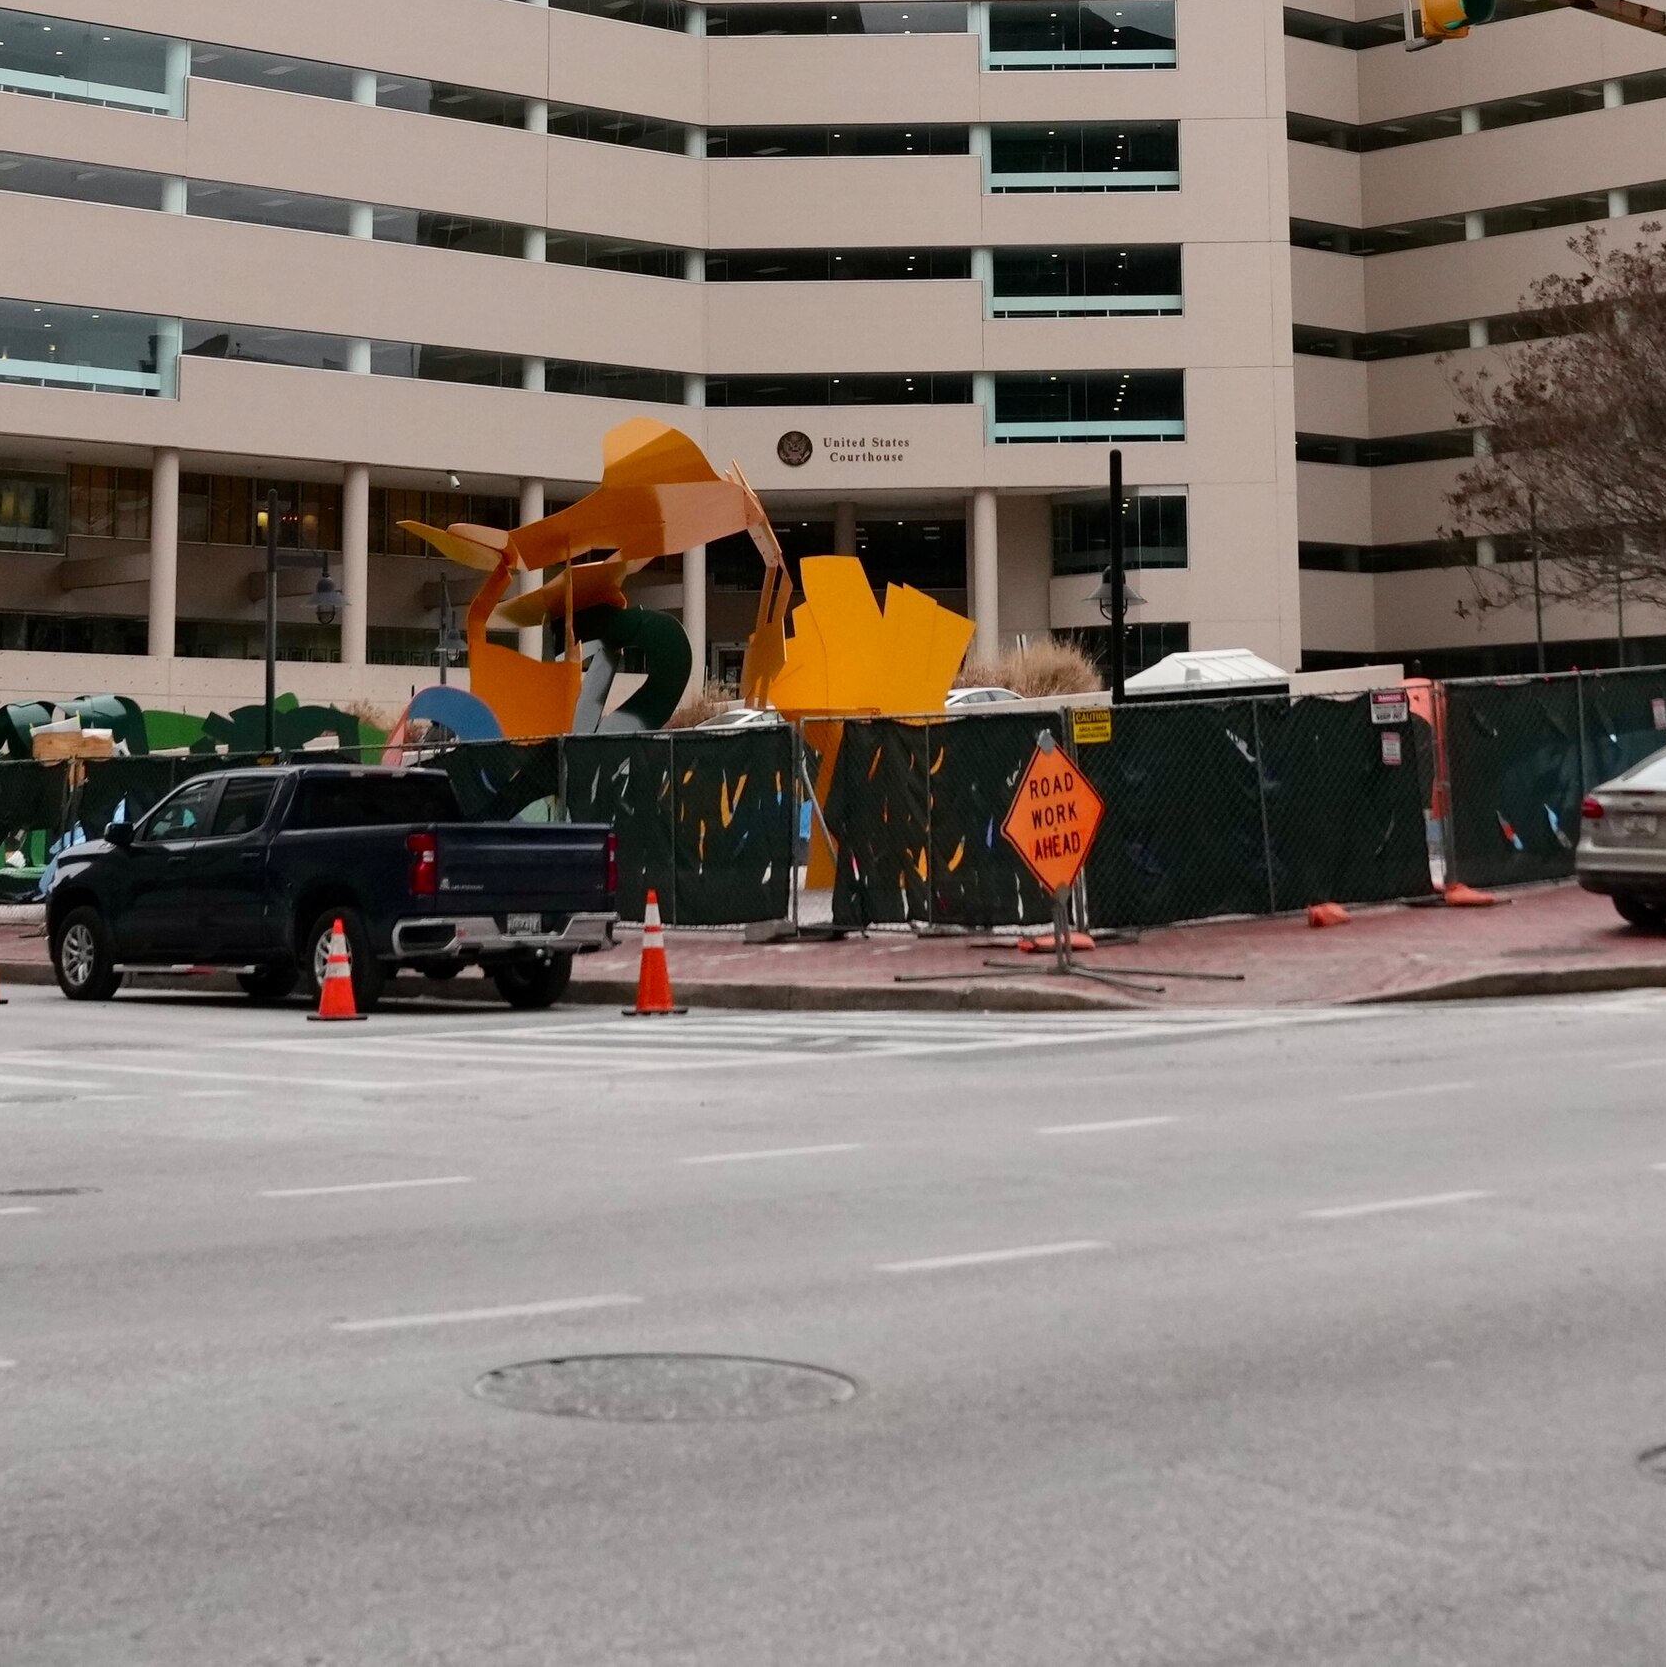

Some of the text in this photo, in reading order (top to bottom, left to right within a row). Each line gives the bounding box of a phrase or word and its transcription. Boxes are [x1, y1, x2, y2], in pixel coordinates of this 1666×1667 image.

[823, 437, 910, 448] United States
[829, 452, 904, 462] Courthouse
[1029, 772, 1074, 800] ROAD
[1031, 801, 1077, 829] WORK
[1034, 831, 1081, 862] AHEAD
